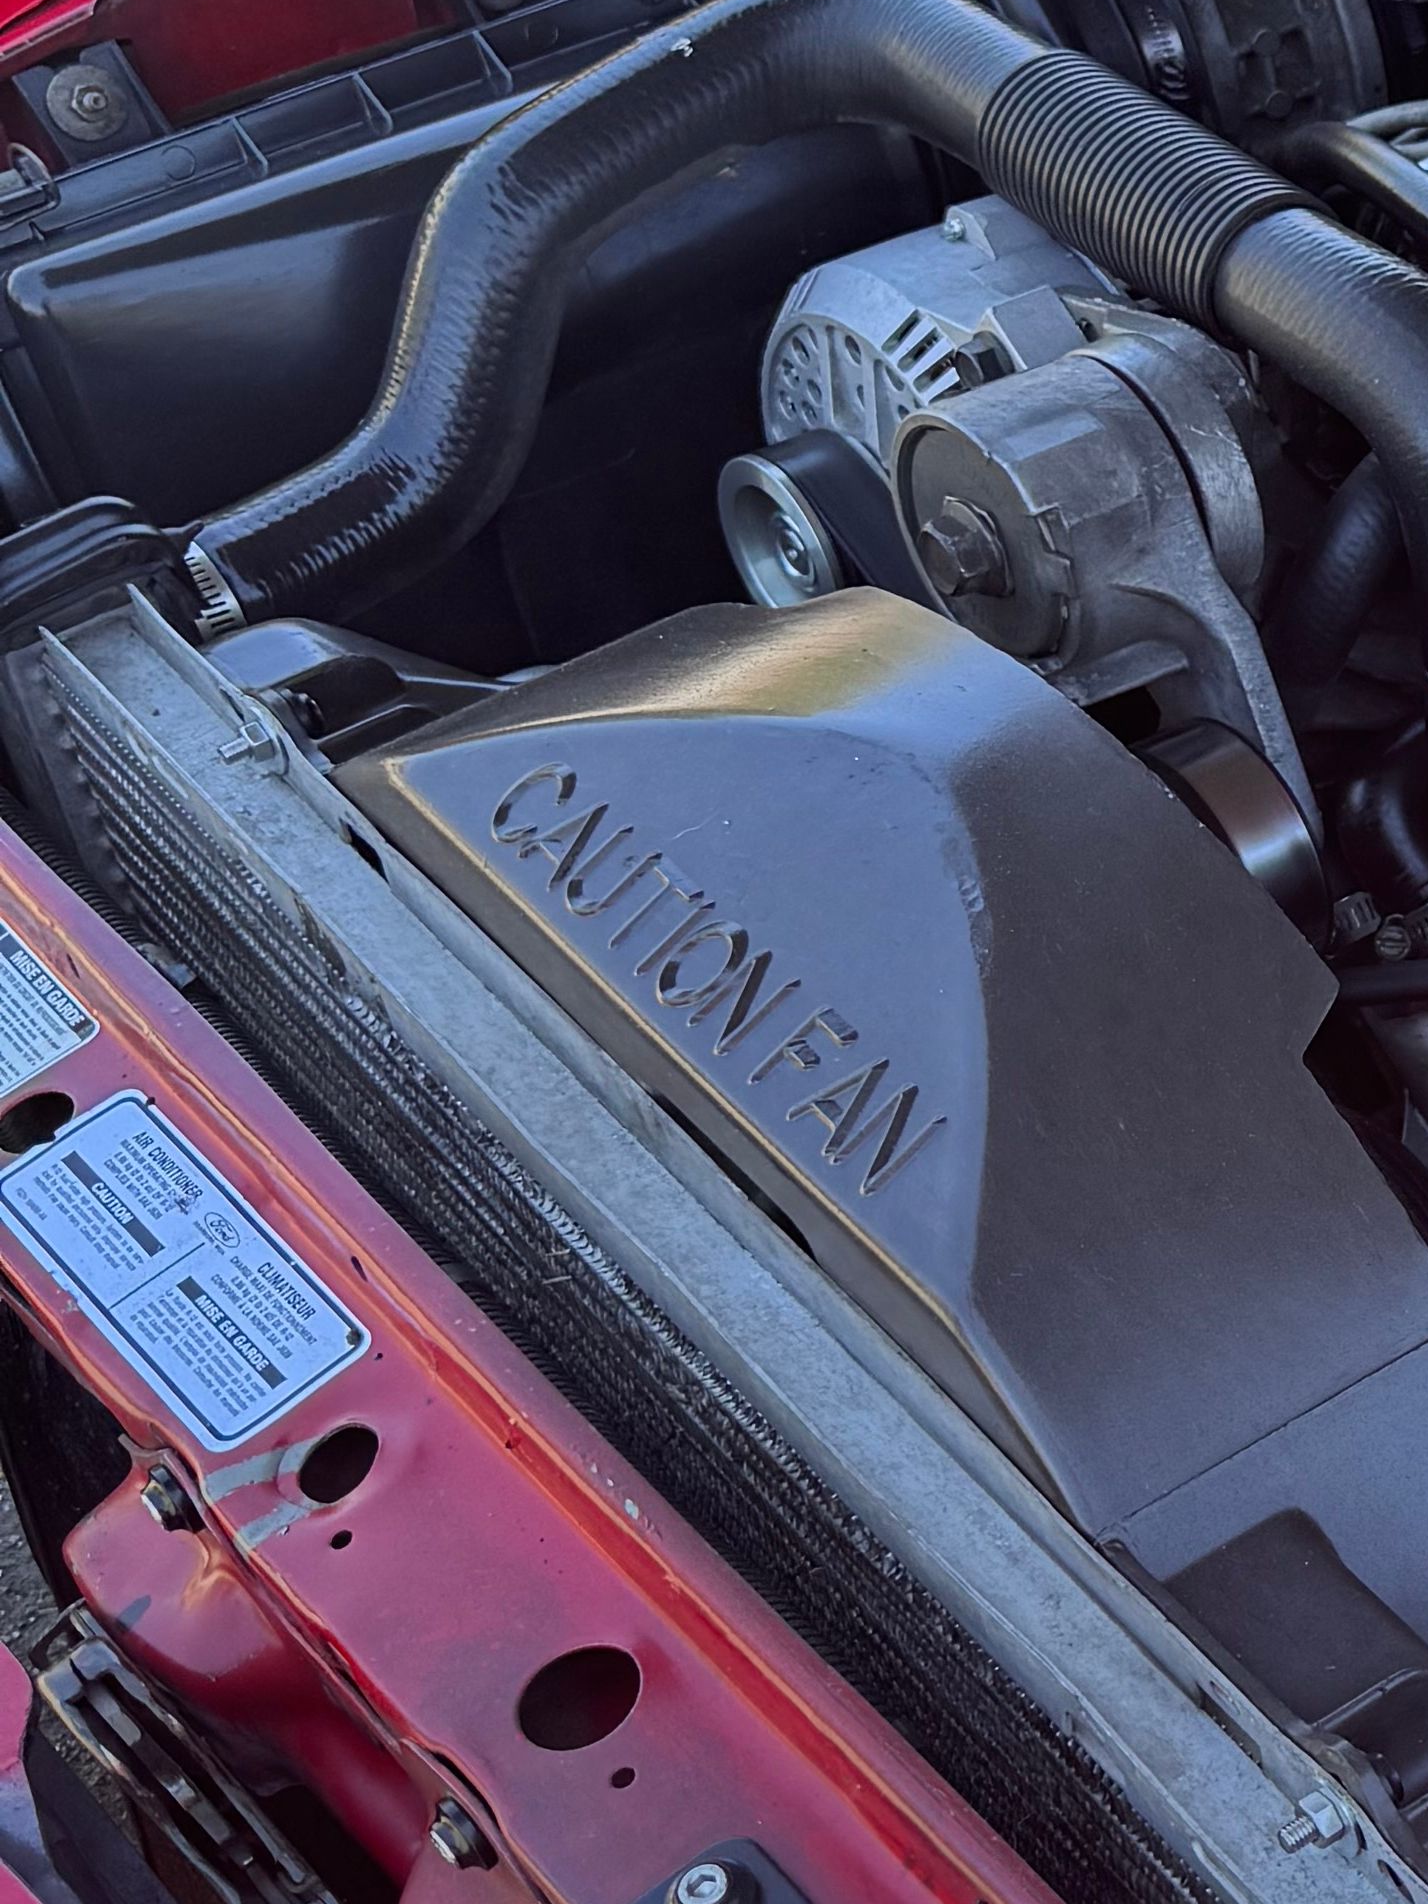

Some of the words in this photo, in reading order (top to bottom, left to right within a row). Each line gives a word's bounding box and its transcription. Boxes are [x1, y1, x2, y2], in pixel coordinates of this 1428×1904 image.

[8, 948, 41, 981] MISE
[31, 973, 54, 996] EN
[44, 987, 85, 1029] GARDE
[490, 760, 802, 1056] CAUTION
[749, 1006, 947, 1197] FAN
[90, 1180, 133, 1226] CAUTION
[131, 1128, 154, 1151] AIR
[146, 1144, 204, 1204] CONDITIONER
[207, 1215, 236, 1244] Ford
[256, 1259, 316, 1322] CLIMATISEUR
[194, 1292, 224, 1323] MISE
[218, 1318, 238, 1338] EN
[231, 1332, 269, 1372] GARDE
